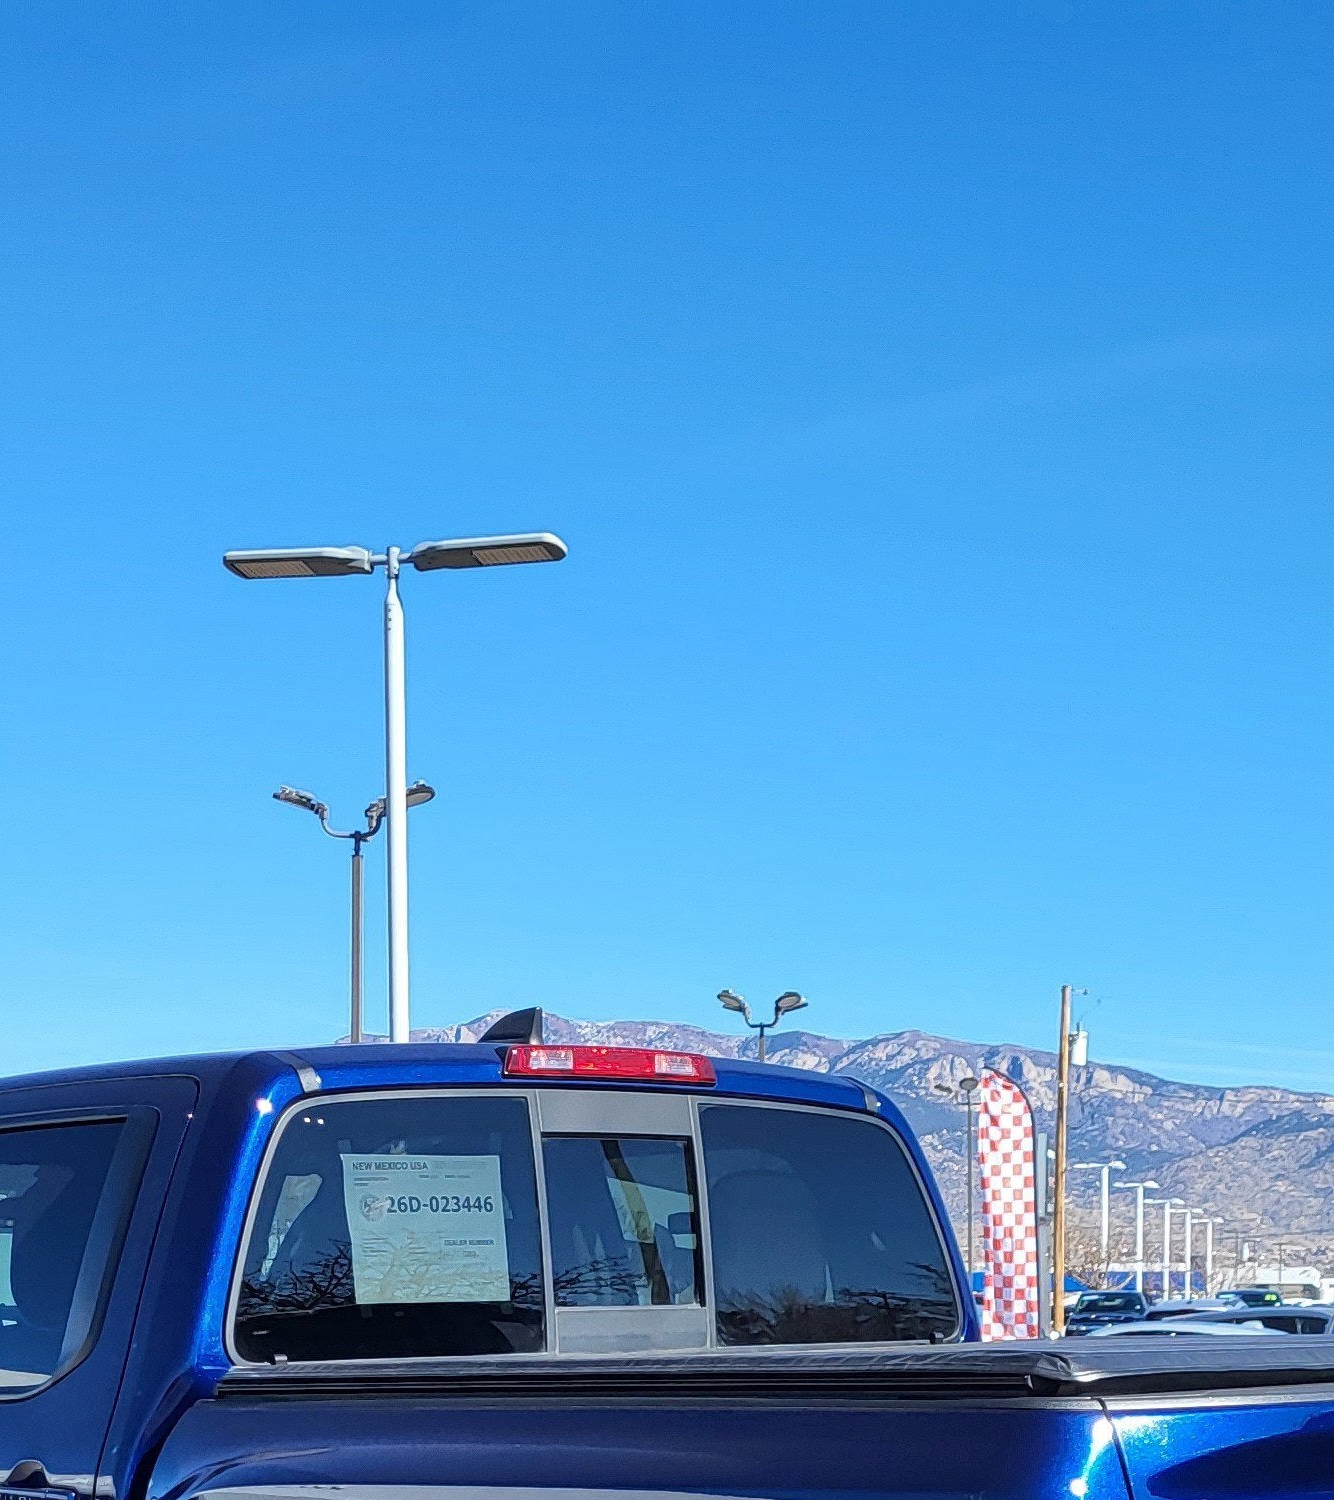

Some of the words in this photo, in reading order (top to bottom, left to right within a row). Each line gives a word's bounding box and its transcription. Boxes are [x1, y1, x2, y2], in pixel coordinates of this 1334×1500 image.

[352, 1161, 372, 1171] NEW
[374, 1161, 409, 1171] MEXICO
[410, 1161, 429, 1171] USA
[387, 1195, 495, 1214] 26D-023446
